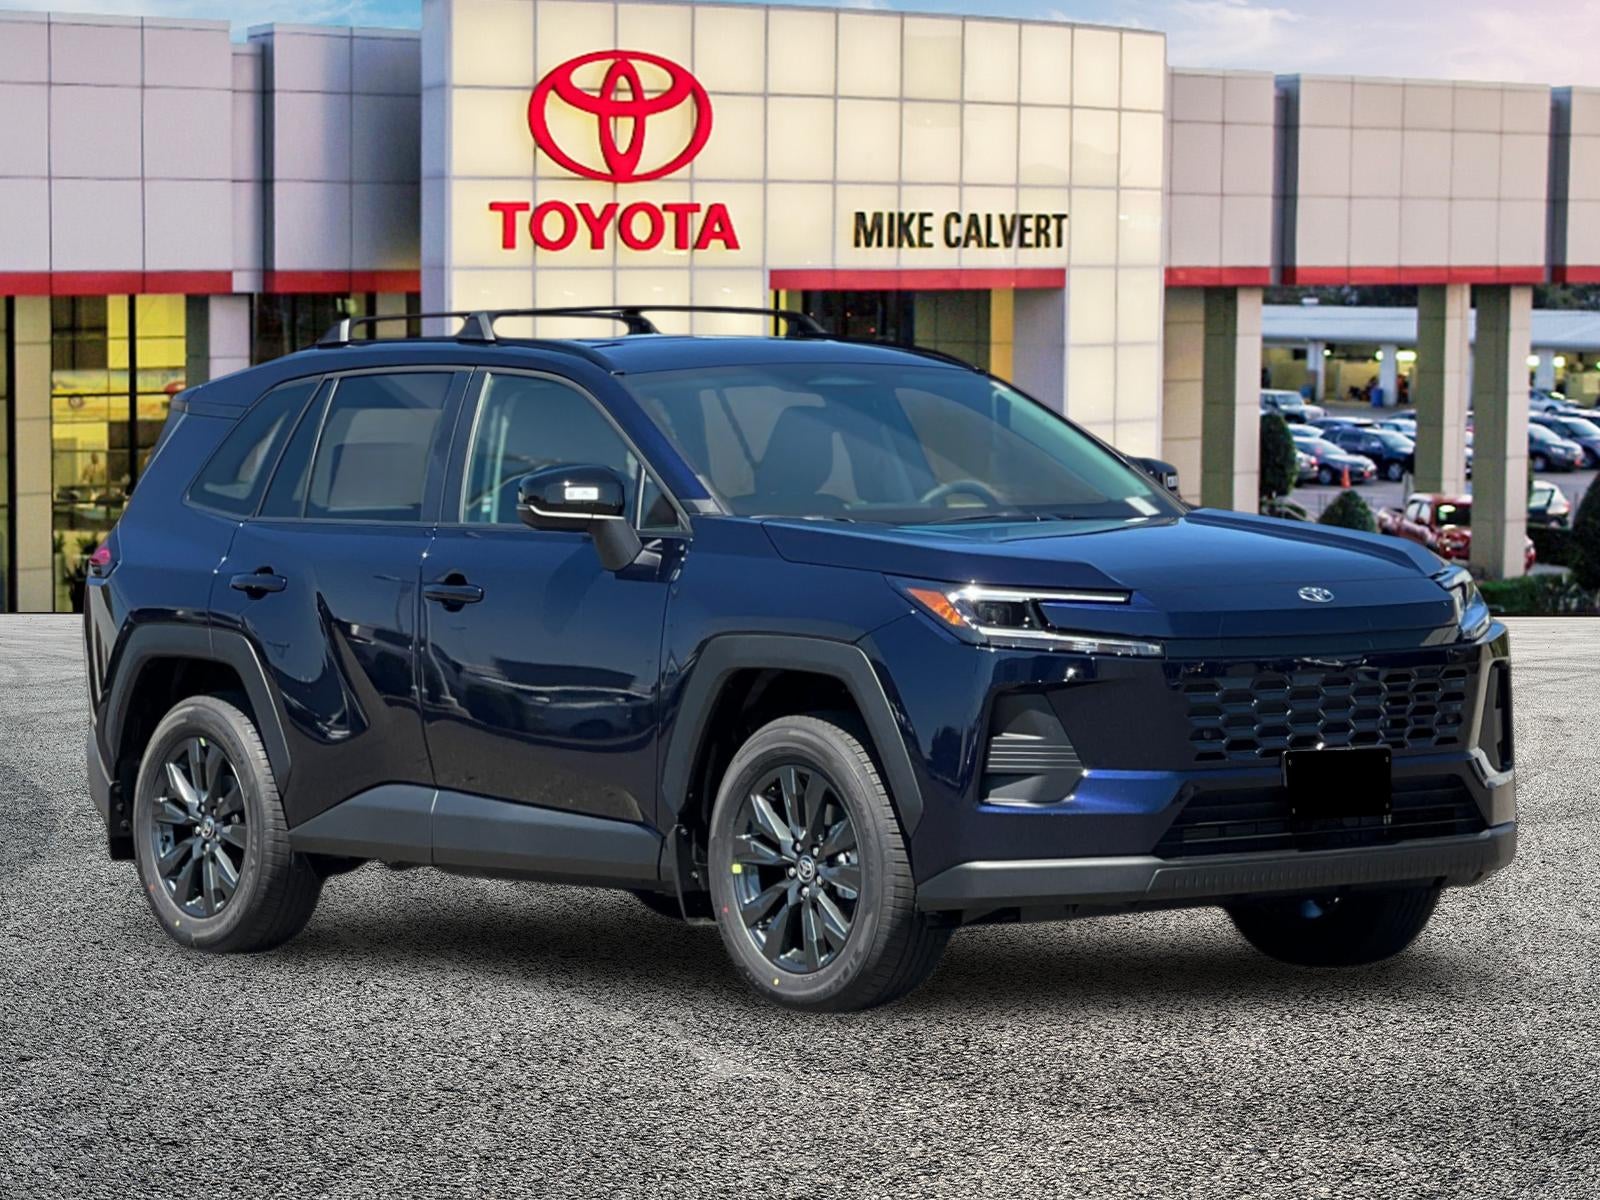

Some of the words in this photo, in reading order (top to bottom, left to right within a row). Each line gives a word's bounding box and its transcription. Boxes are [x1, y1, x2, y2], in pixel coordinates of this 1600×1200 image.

[488, 200, 740, 251] TOYOTA
[853, 211, 934, 249] MIKE
[943, 211, 1068, 249] CALVERT
